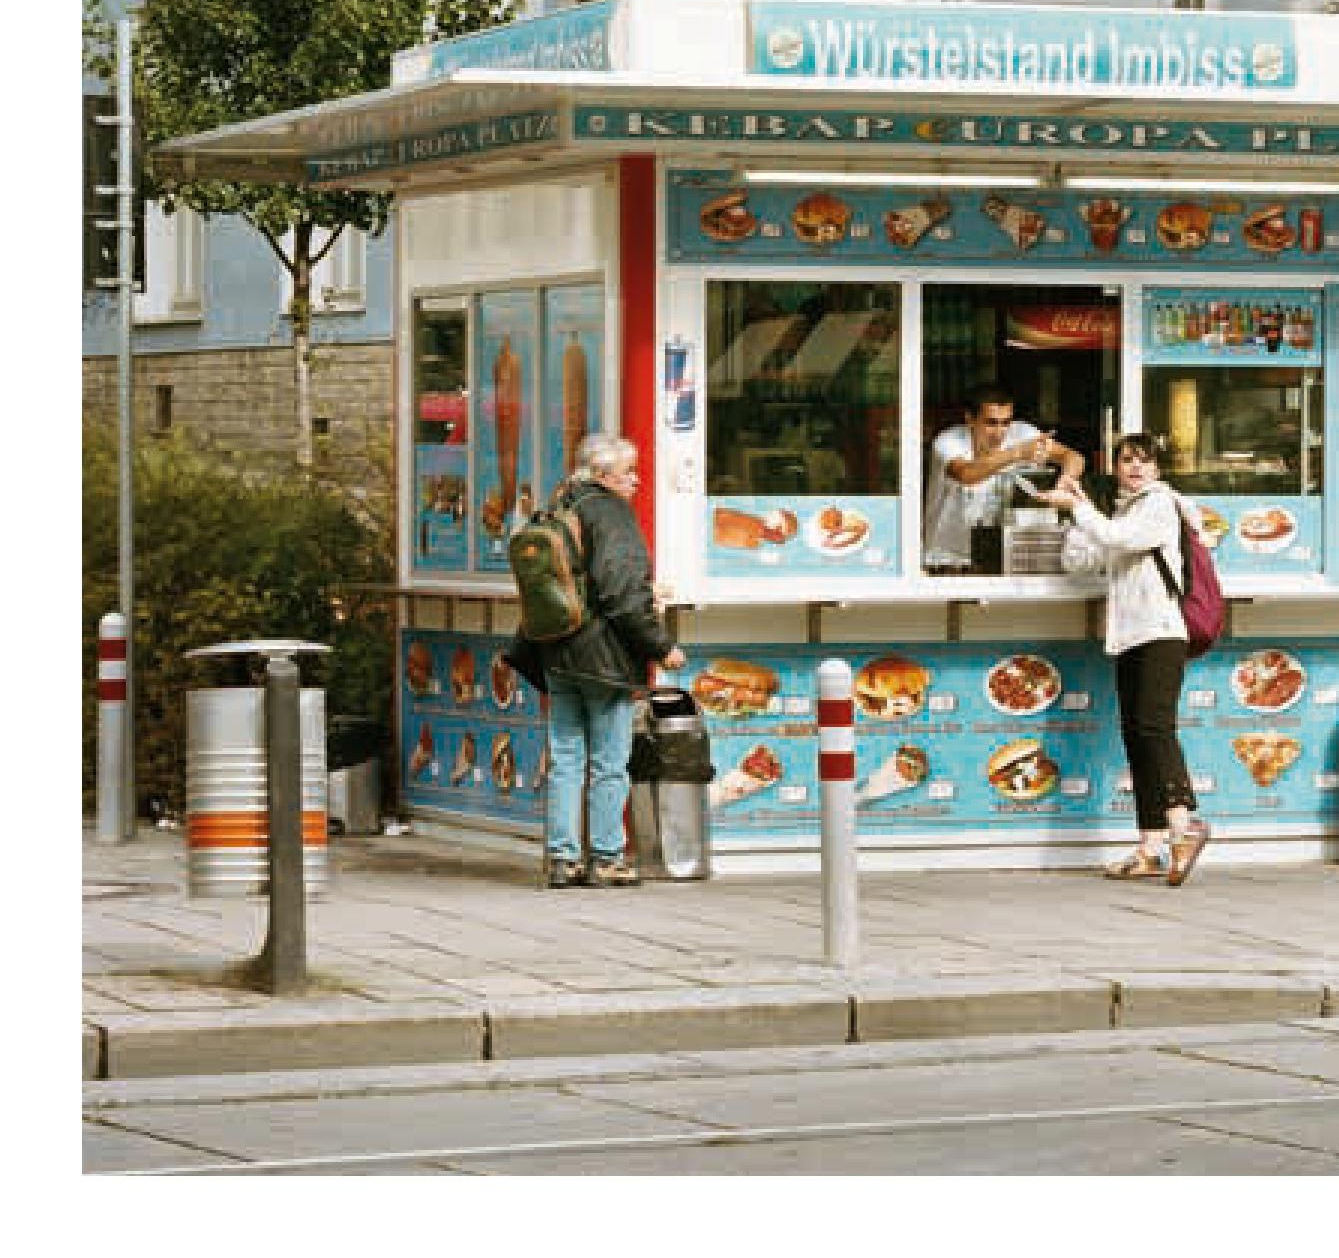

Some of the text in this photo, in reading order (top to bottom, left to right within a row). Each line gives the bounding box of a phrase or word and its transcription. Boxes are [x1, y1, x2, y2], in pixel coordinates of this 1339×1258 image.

[808, 19, 1246, 88] Würstelstand Imbiss
[627, 112, 894, 139] KEBAP
